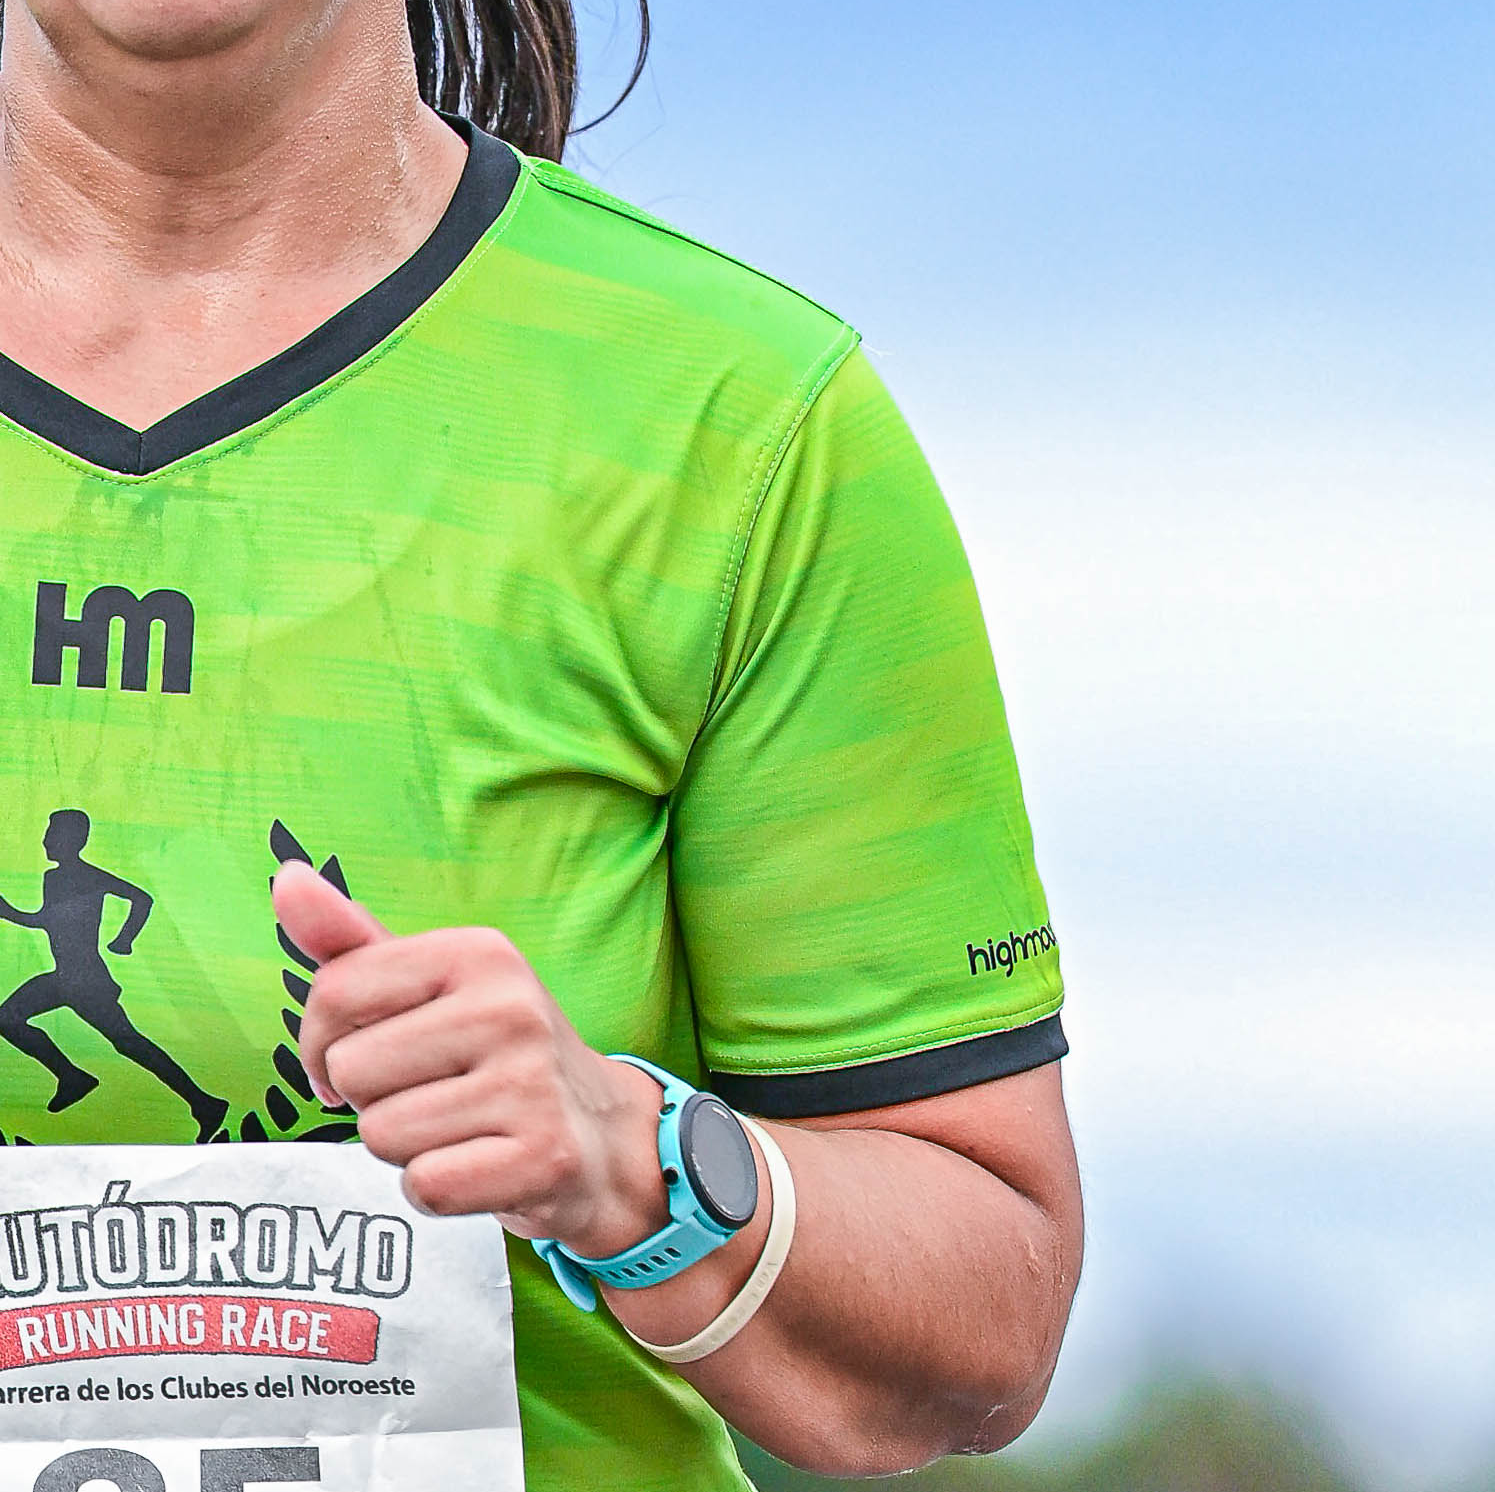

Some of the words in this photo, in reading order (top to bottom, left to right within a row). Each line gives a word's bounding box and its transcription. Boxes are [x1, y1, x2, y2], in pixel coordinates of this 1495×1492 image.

[17, 1302, 205, 1361] RUNNING
[221, 1304, 333, 1356] RACE
[76, 1377, 109, 1402] de
[116, 1376, 155, 1401] los
[160, 1375, 248, 1400] Clubes
[253, 1374, 295, 1400] del
[300, 1373, 416, 1398] Noroeste
